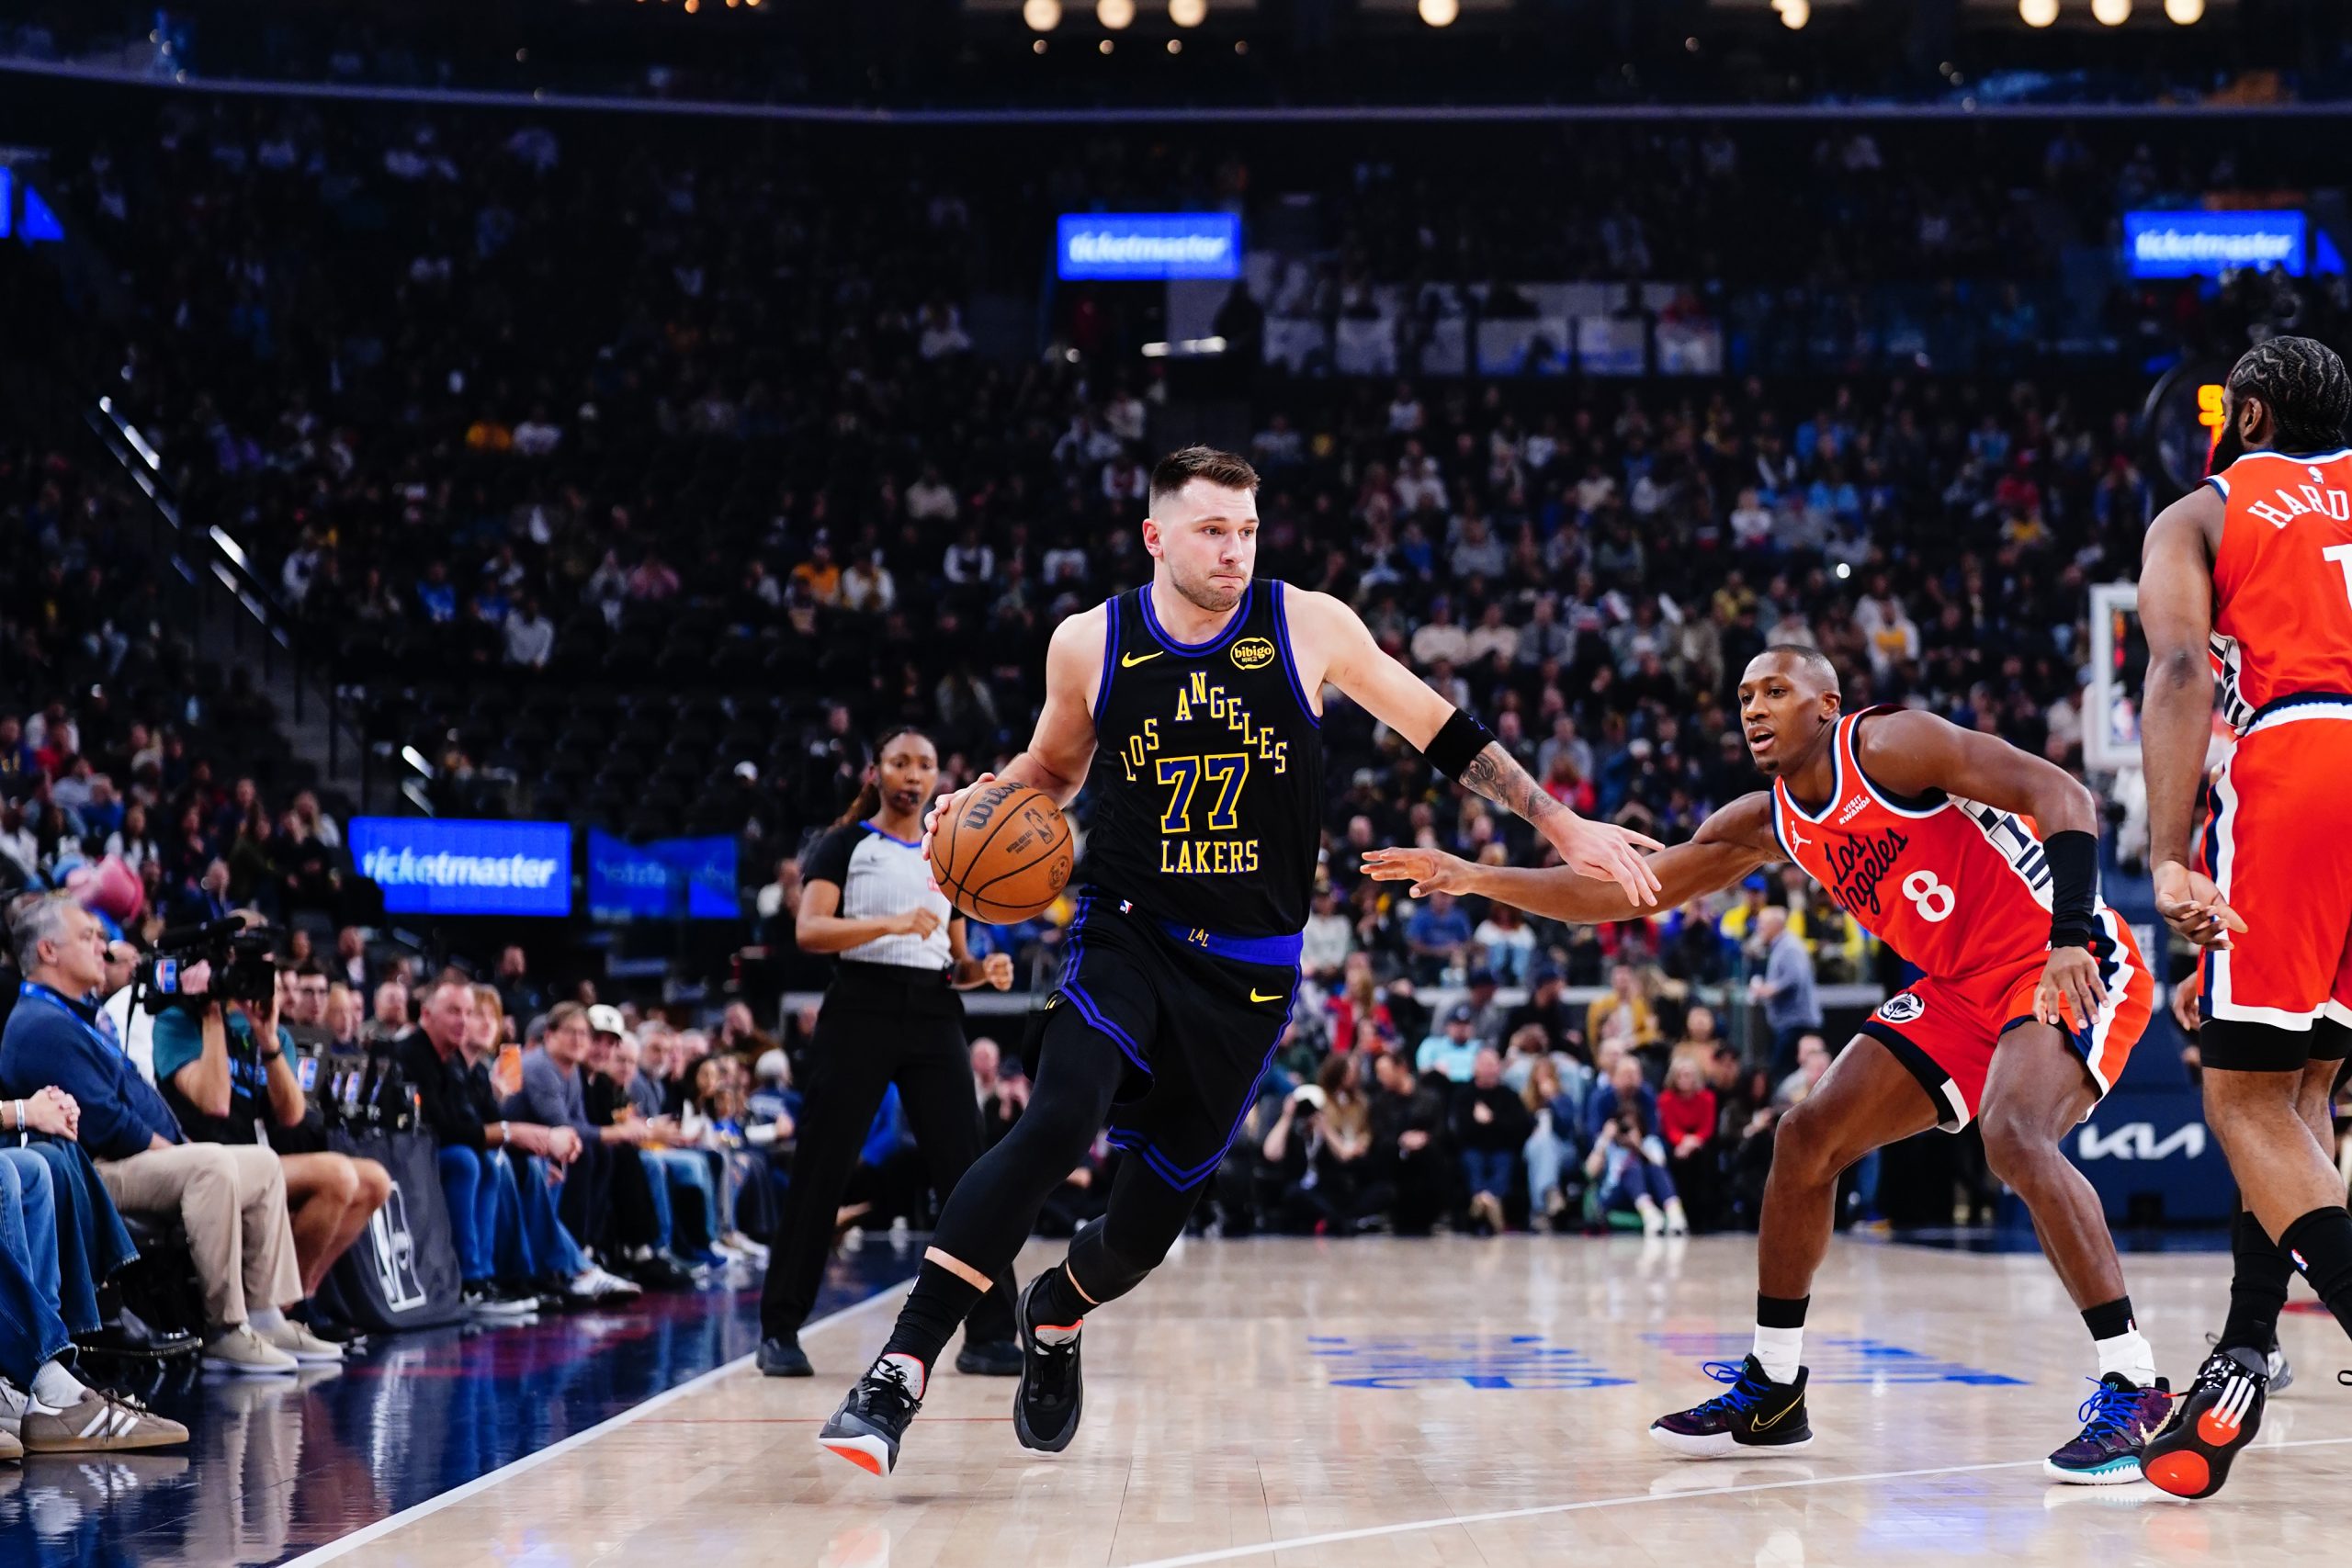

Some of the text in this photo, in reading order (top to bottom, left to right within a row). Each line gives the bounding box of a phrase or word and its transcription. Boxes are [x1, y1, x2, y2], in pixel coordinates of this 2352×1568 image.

[2247, 484, 2350, 529] HARD
[1234, 645, 1272, 659] bibigo
[1119, 671, 1288, 782] LOS ANGELES
[963, 782, 1030, 829] Wilso
[1155, 751, 1250, 835] 77
[1838, 795, 1871, 826] RWANDA
[1843, 794, 1862, 813] VISIT
[363, 846, 558, 888] ticketmaster
[1160, 839, 1259, 874] LAKERS
[1824, 833, 1866, 886] Los
[1832, 827, 1909, 918] Angeles
[1902, 869, 1956, 923] 8
[1187, 928, 1210, 948] LAL
